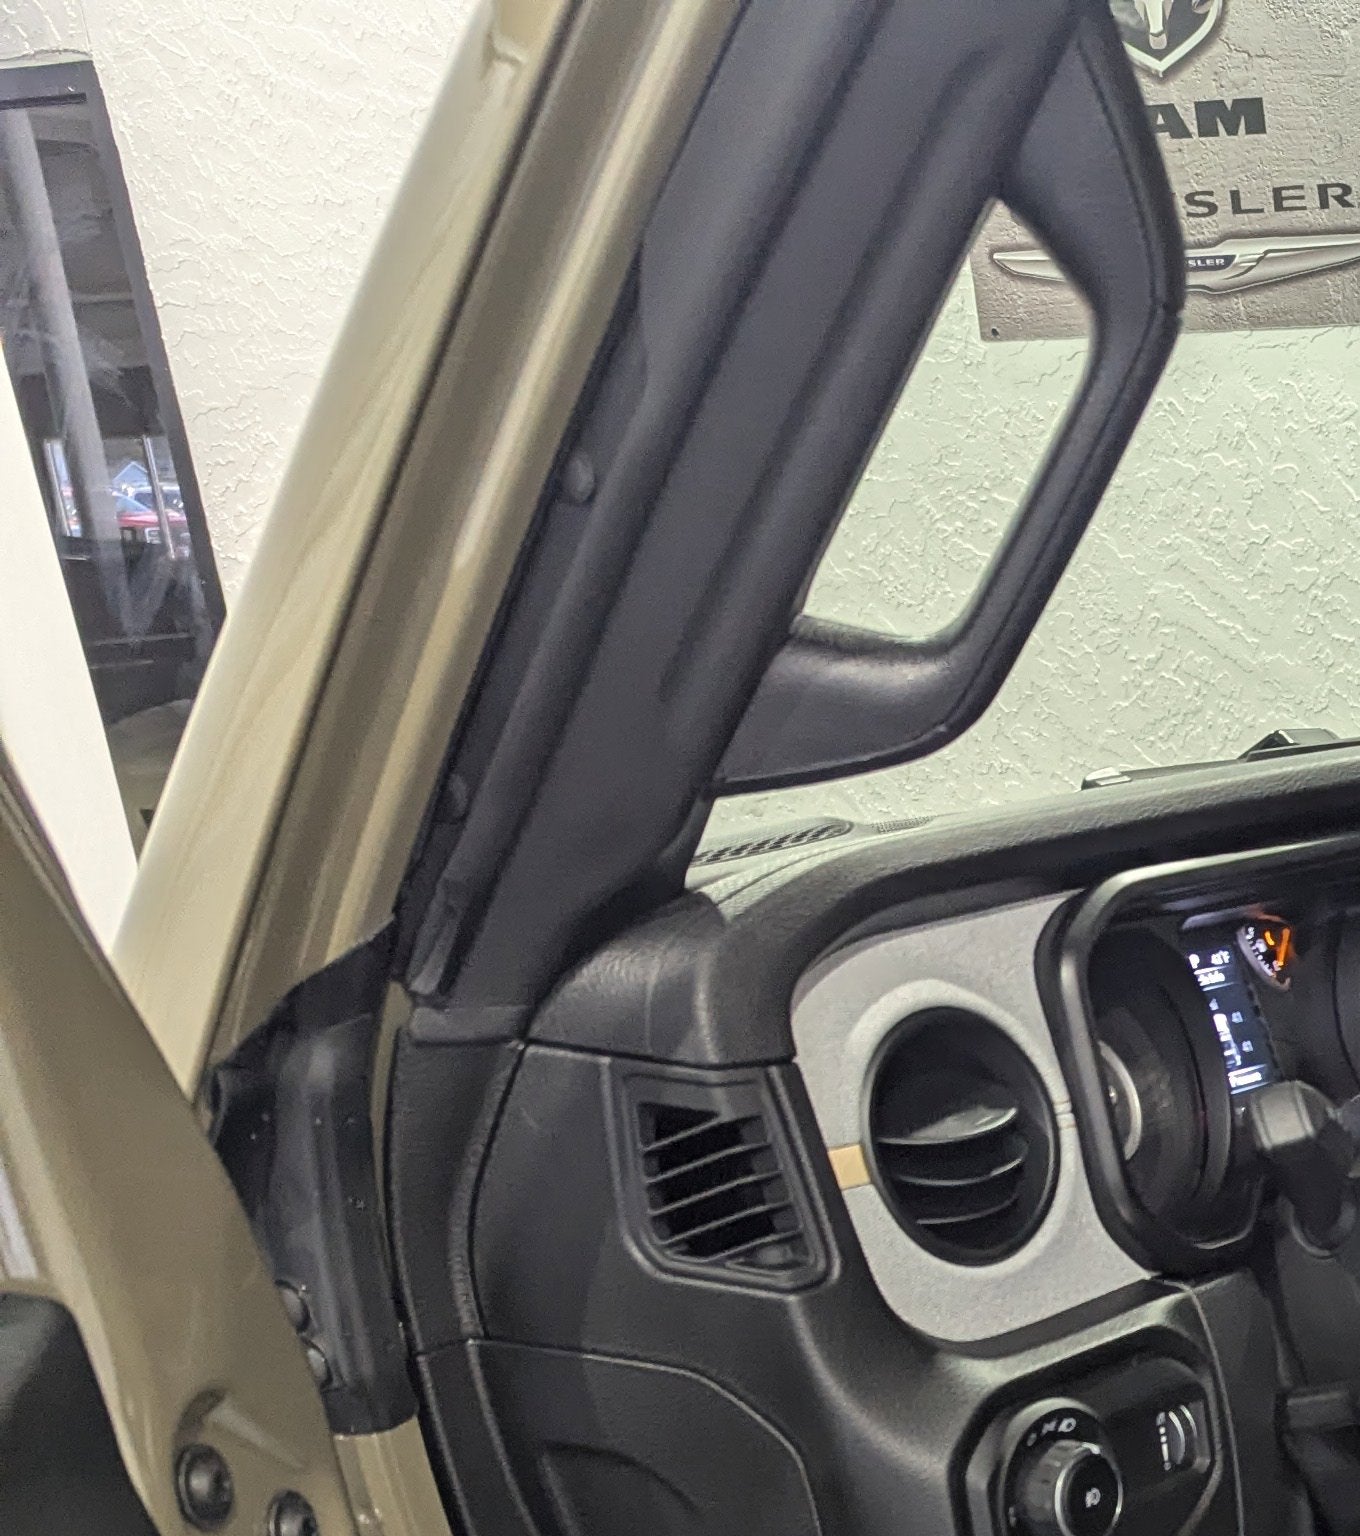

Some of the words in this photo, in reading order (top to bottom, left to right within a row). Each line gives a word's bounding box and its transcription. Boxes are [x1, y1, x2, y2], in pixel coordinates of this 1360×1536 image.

[1146, 97, 1266, 139] AM
[1183, 183, 1355, 217] SLER
[1187, 257, 1225, 268] SLER
